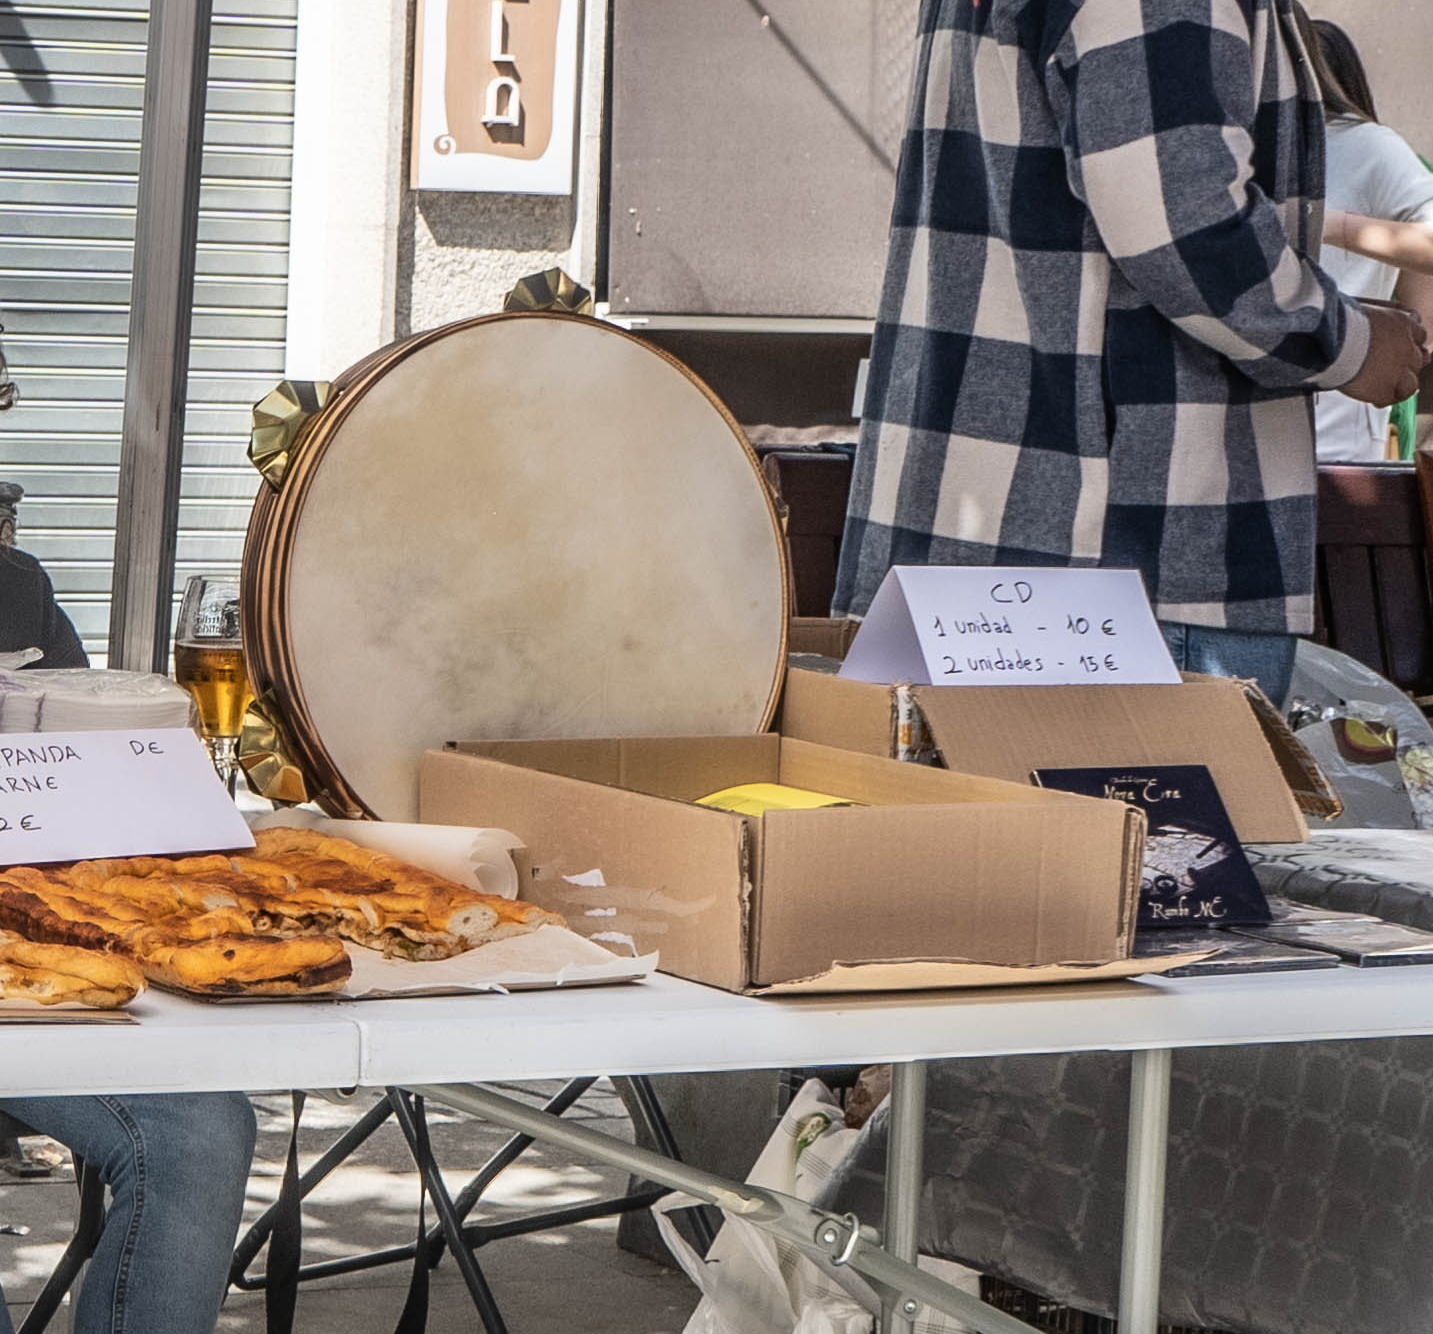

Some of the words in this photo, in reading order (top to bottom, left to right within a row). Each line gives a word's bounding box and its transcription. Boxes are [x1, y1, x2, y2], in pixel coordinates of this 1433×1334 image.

[990, 581, 1033, 604] CD
[933, 615, 947, 638] 1
[954, 611, 1013, 635] unidad
[1066, 613, 1090, 635] 10
[943, 655, 963, 675] 2
[967, 647, 1044, 672] unidades
[129, 740, 164, 756] DE
